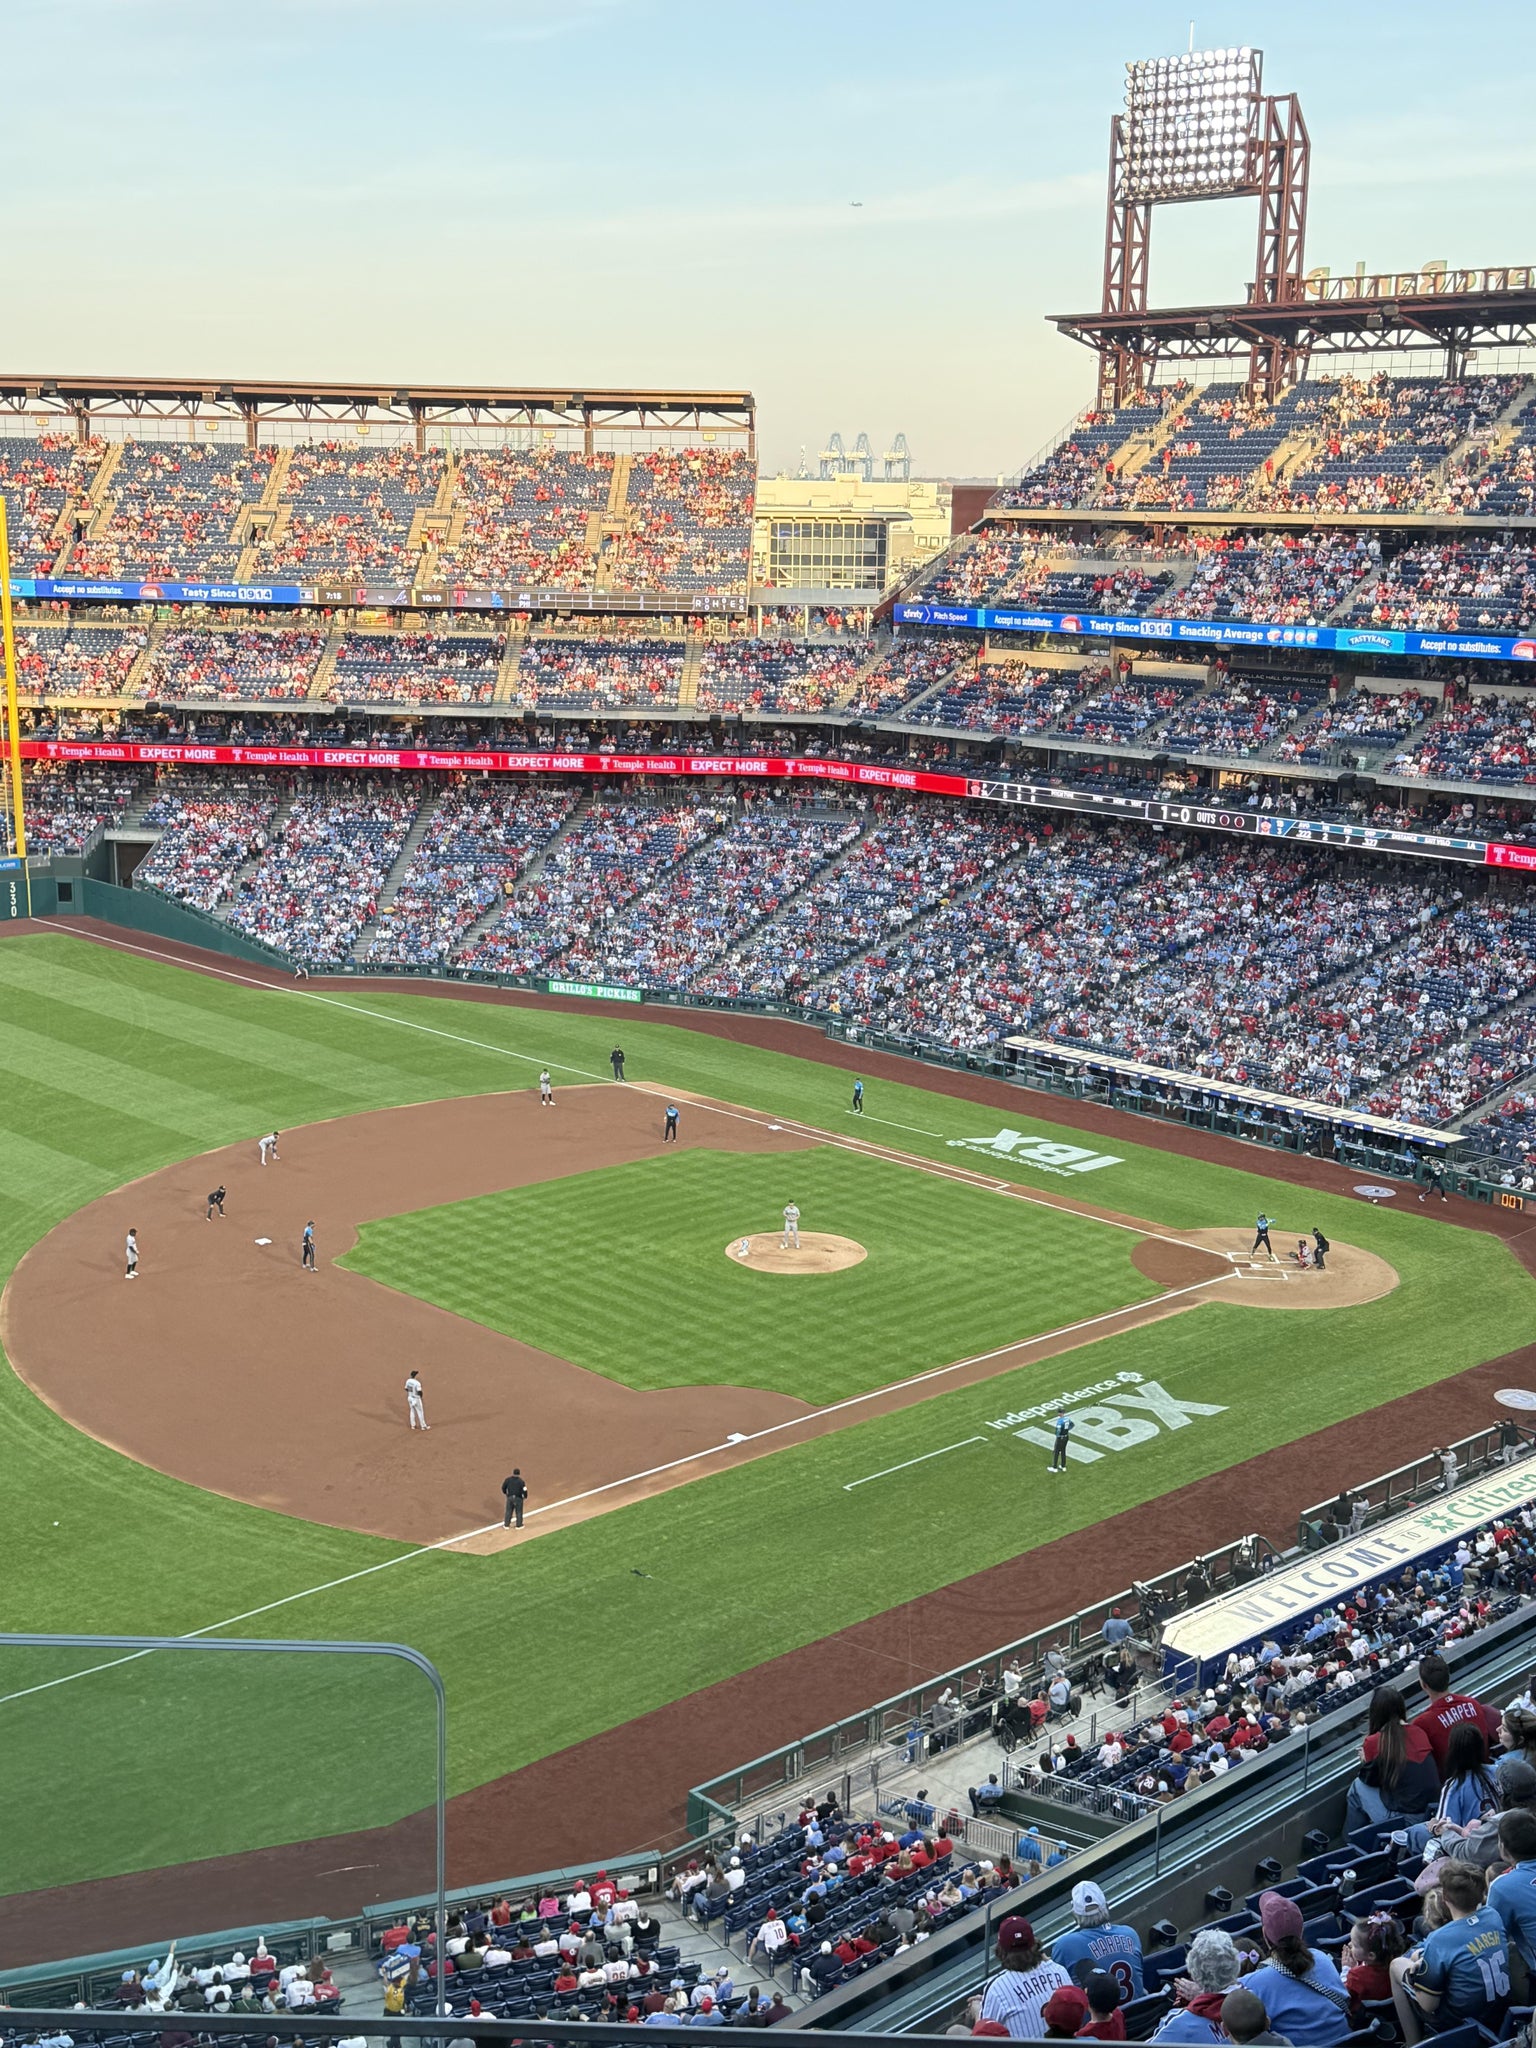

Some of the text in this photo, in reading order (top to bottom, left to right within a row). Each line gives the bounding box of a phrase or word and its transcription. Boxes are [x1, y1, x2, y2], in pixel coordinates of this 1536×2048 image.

[53, 584, 76, 594] Accept
[181, 588, 272, 600] Tasty Since 1914
[326, 592, 342, 600] 7:15
[421, 594, 442, 602] 10:10
[903, 609, 923, 619] xfinity
[934, 612, 967, 622] Pitch Speed
[994, 615, 1013, 626] Accept
[1090, 620, 1114, 633] Tasty
[1116, 622, 1139, 632] Since
[1140, 622, 1172, 636] 1914
[1180, 626, 1263, 641] Snacking Average
[1350, 634, 1392, 648] TASTYKAKE
[1420, 639, 1446, 652] Accept
[1448, 643, 1457, 651] no
[60, 746, 93, 757] Temple
[95, 748, 125, 757] Health
[140, 748, 216, 760] EXPECT MORE
[245, 751, 277, 762] Temple
[279, 752, 309, 762] Health
[324, 752, 400, 764] EXPECT MORE
[429, 756, 461, 767] Temple
[464, 756, 493, 766] Health
[508, 757, 584, 768] EXPECT MORE
[613, 760, 644, 770] Temple
[646, 760, 676, 770] Health
[691, 760, 768, 772] EXPECT MORE
[798, 763, 826, 775] Temple
[828, 765, 849, 776] Health
[860, 769, 916, 785] EXPECT MORE
[1160, 806, 1216, 824] 1-0 OUTS
[1392, 833, 1417, 843] DISTANCE
[552, 981, 638, 1000] GRILLO'S PICKLES
[1388, 1124, 1439, 1136] HOME
[961, 1128, 1126, 1172] IBX
[966, 1145, 1076, 1177] Independence
[1502, 1193, 1523, 1210] 007
[985, 1378, 1121, 1430] Independence
[1012, 1380, 1230, 1464] IBX
[1224, 1536, 1411, 1624] WELCOME
[1401, 1532, 1421, 1540] TO
[1438, 1702, 1478, 1728] HARPER
[774, 1928, 784, 1939] 10
[1088, 1935, 1134, 1960] HARPER
[1466, 1930, 1500, 1956] MARSH
[1109, 1960, 1134, 2004] 3
[1476, 1950, 1511, 2002] 16
[1013, 1972, 1063, 2003] HARPER
